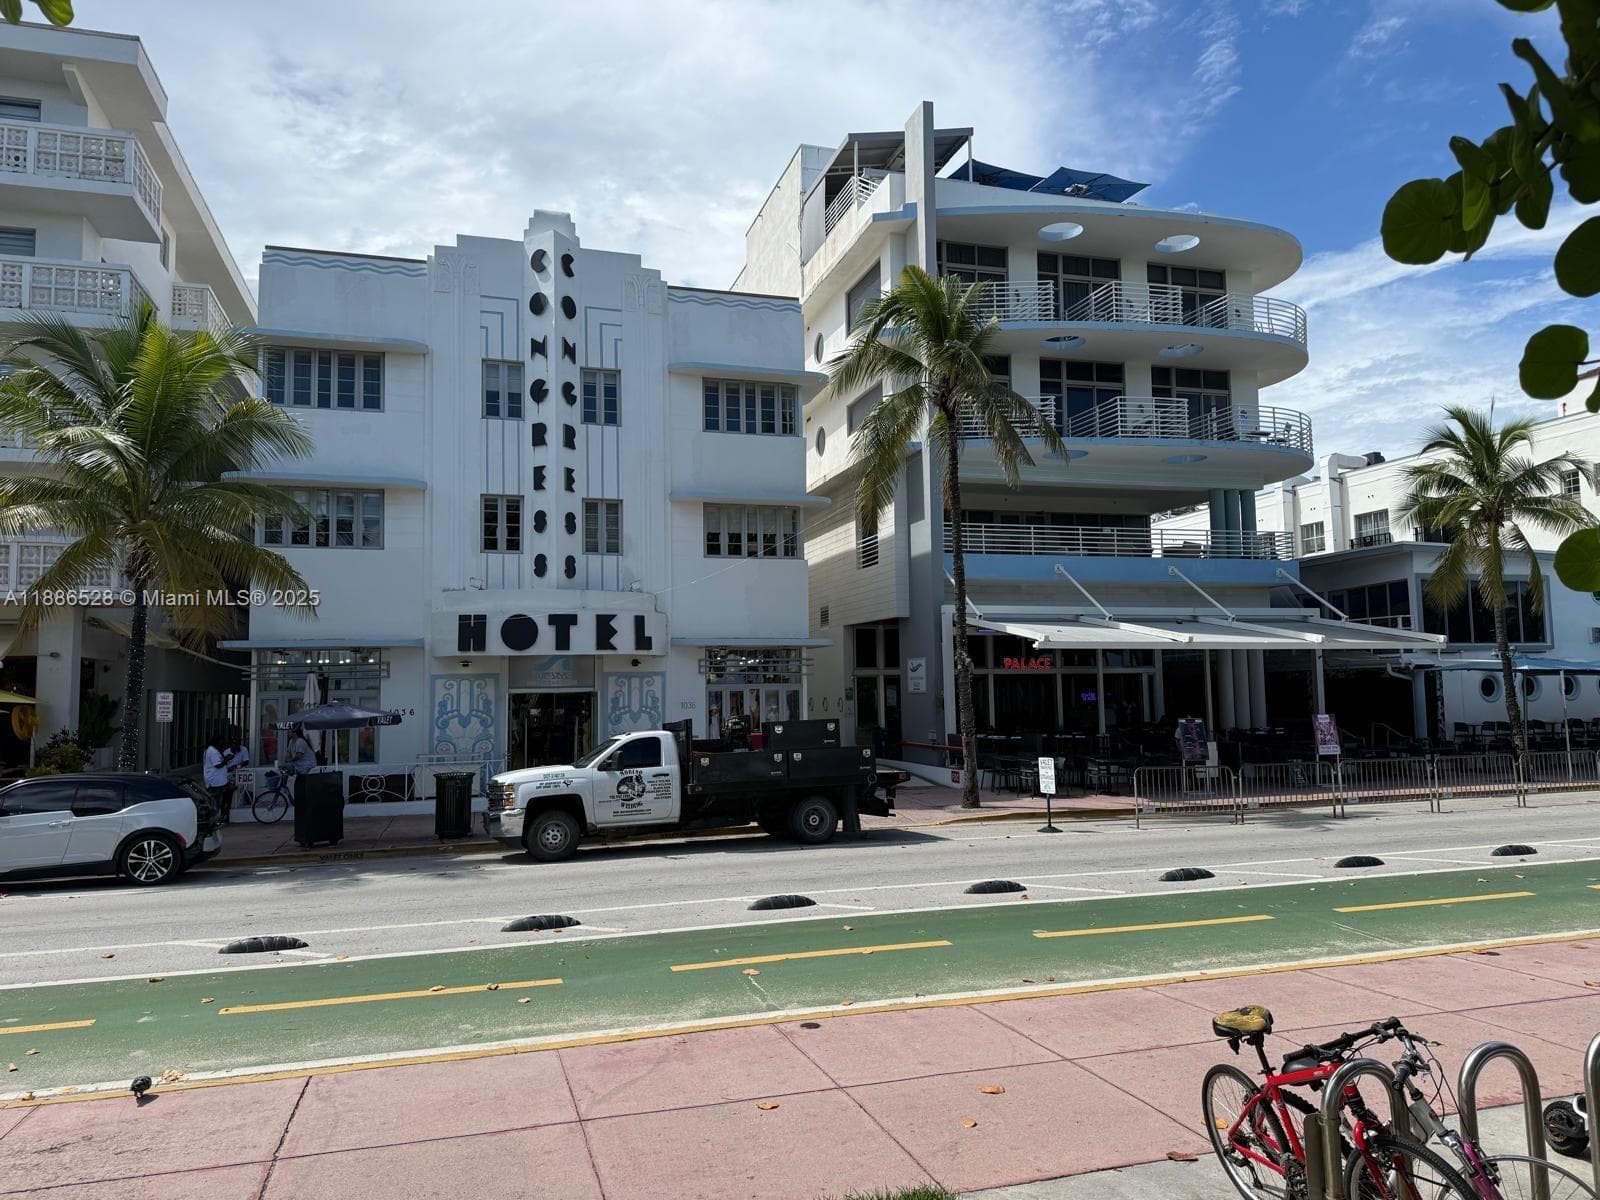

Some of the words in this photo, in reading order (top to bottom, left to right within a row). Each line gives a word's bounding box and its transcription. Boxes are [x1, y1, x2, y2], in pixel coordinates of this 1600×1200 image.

[530, 249, 549, 578] CONGRESS
[561, 253, 577, 579] CONGRESS
[458, 614, 652, 652] HOTEL
[1003, 658, 1052, 670] PALACE
[276, 721, 294, 729] VALET
[377, 716, 393, 724] VALET
[238, 773, 253, 783] FDC
